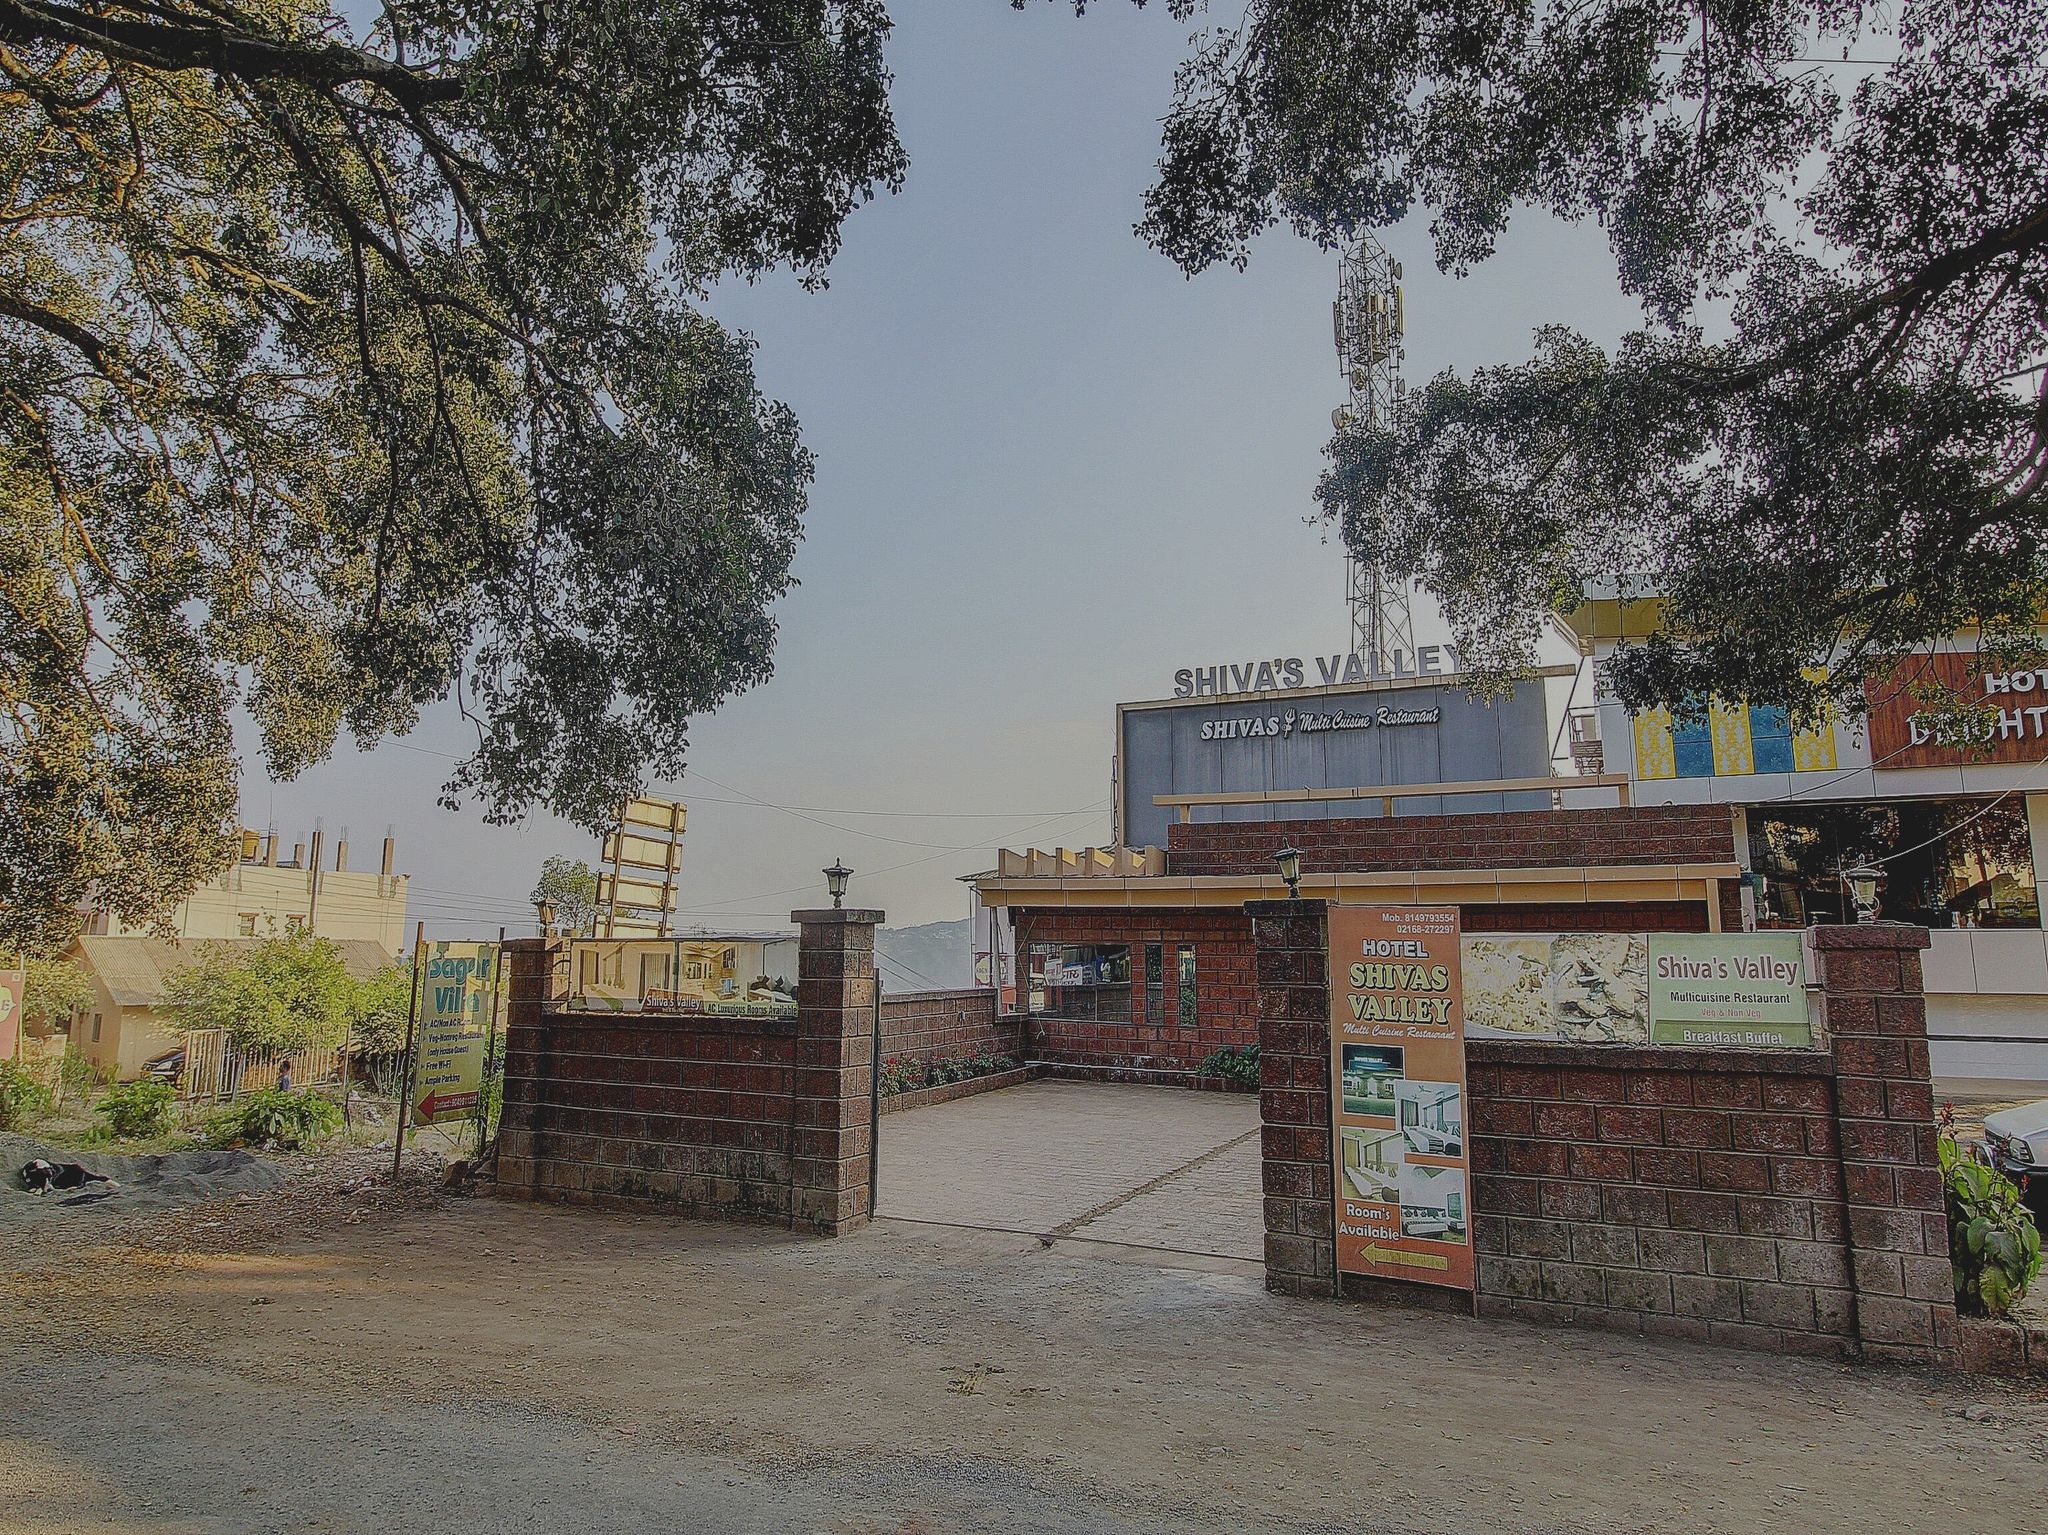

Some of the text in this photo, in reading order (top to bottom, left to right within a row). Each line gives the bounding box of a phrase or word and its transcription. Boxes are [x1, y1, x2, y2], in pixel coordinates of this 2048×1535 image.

[1174, 644, 1462, 699] SHIVA'S VALLEY
[1200, 706, 1439, 740] SHIVAS Multi Cuisine Restaurant
[1382, 913, 1454, 921] Mob. 8149793554
[1397, 925, 1454, 933] 02168-272297
[1362, 939, 1429, 957] HOTEL
[1350, 962, 1449, 991] SHIVAS
[1657, 956, 1798, 986] Shiva's Valley
[646, 994, 701, 1010] Shiva's Valley
[1670, 991, 1790, 1004] Multicuisine Restaurant
[708, 1004, 797, 1016] AC Luxurious Rooms Available
[1347, 994, 1452, 1024] VALLEY
[1701, 1009, 1716, 1018] Veg
[1727, 1009, 1744, 1017] Non
[1747, 1009, 1761, 1019] Veg
[1343, 1023, 1456, 1039] Multi Cuisine Restaurant
[1683, 1030, 1783, 1045] Breakfast Buffet
[1346, 1203, 1390, 1220] Room's
[1339, 1221, 1399, 1240] Available
